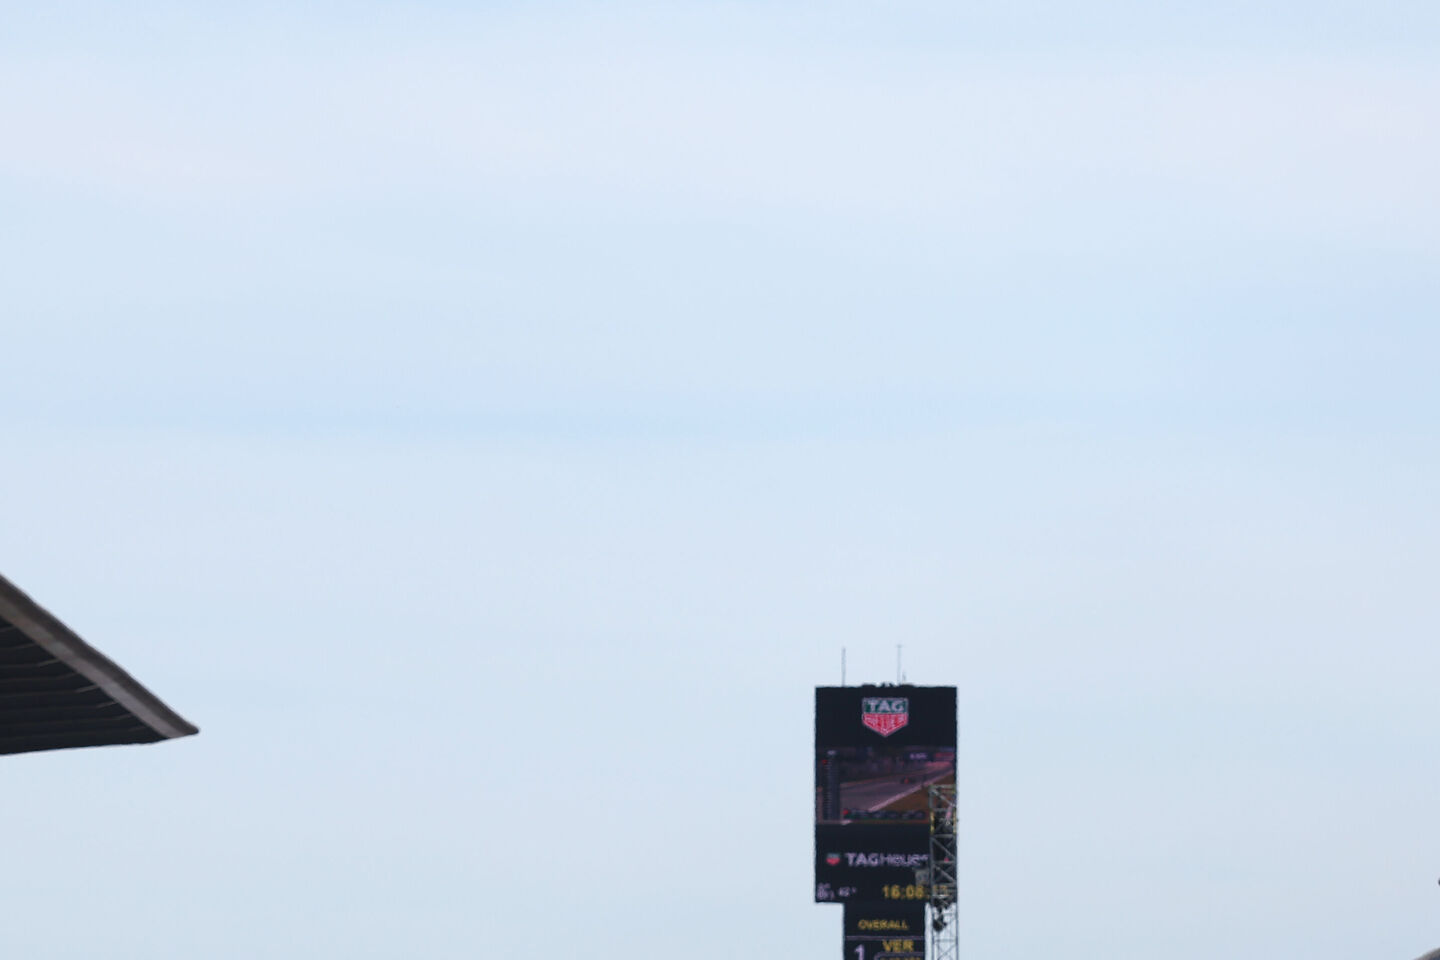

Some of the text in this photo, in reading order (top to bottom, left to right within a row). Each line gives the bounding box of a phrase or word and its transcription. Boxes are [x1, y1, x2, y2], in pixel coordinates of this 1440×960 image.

[868, 699, 905, 712] TAG
[858, 919, 908, 930] OVERALL
[882, 939, 914, 952] VER
